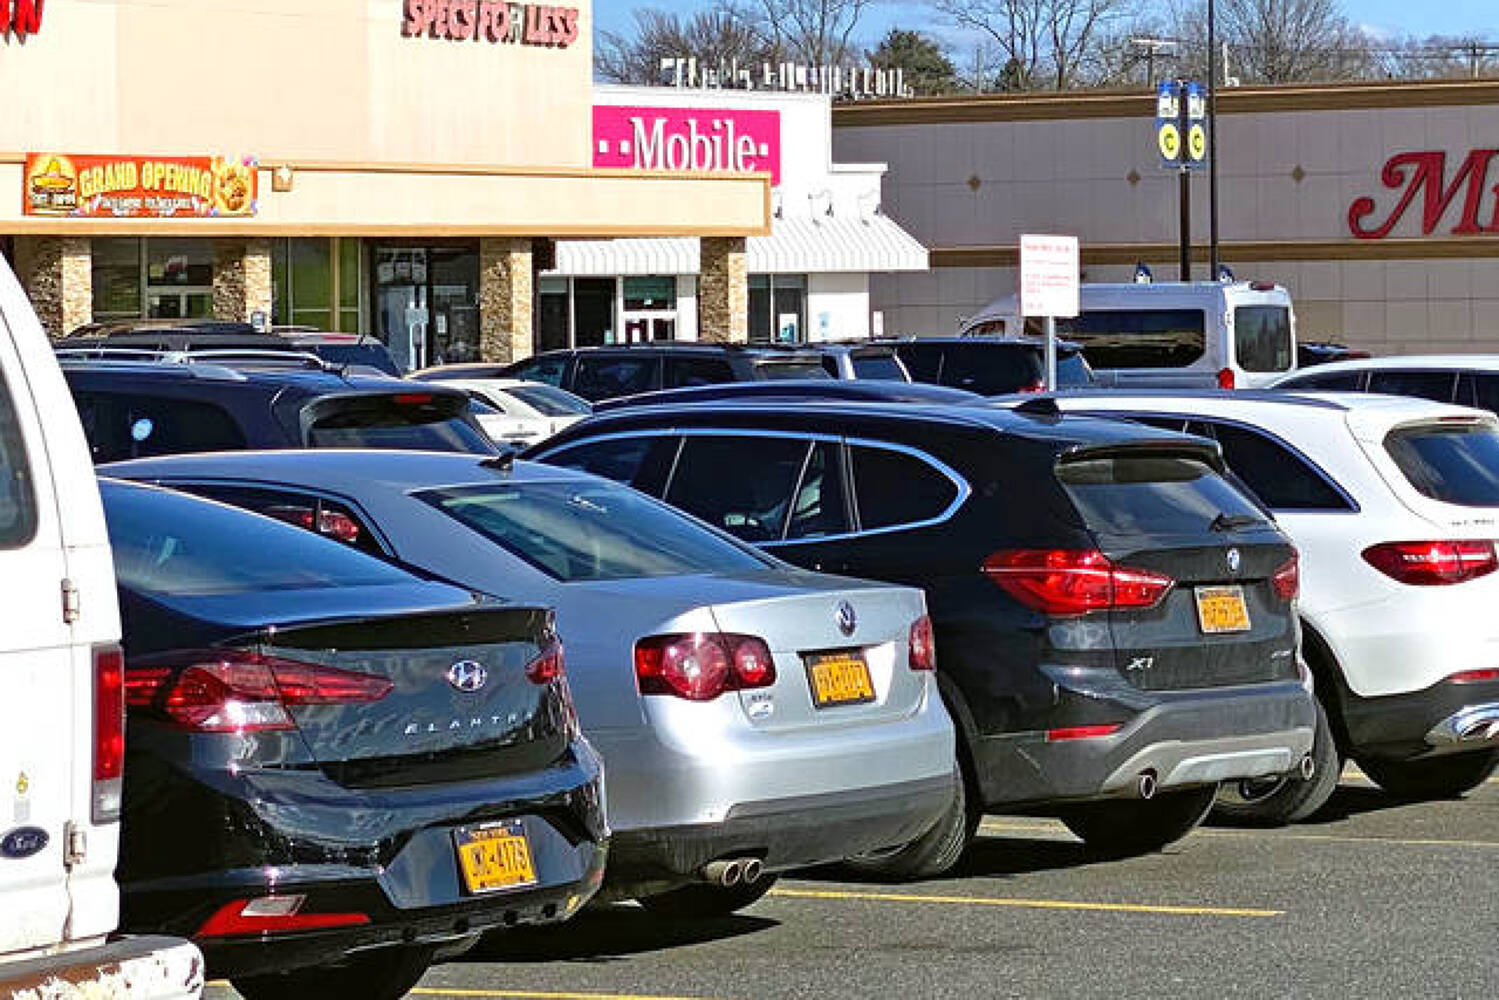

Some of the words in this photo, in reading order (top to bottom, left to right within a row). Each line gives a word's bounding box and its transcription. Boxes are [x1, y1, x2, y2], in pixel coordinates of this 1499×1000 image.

[522, 4, 580, 48] LESS
[629, 117, 757, 171] Mobile
[79, 162, 138, 200] GRAND
[141, 162, 213, 205] OPENING
[1126, 657, 1153, 671] X1
